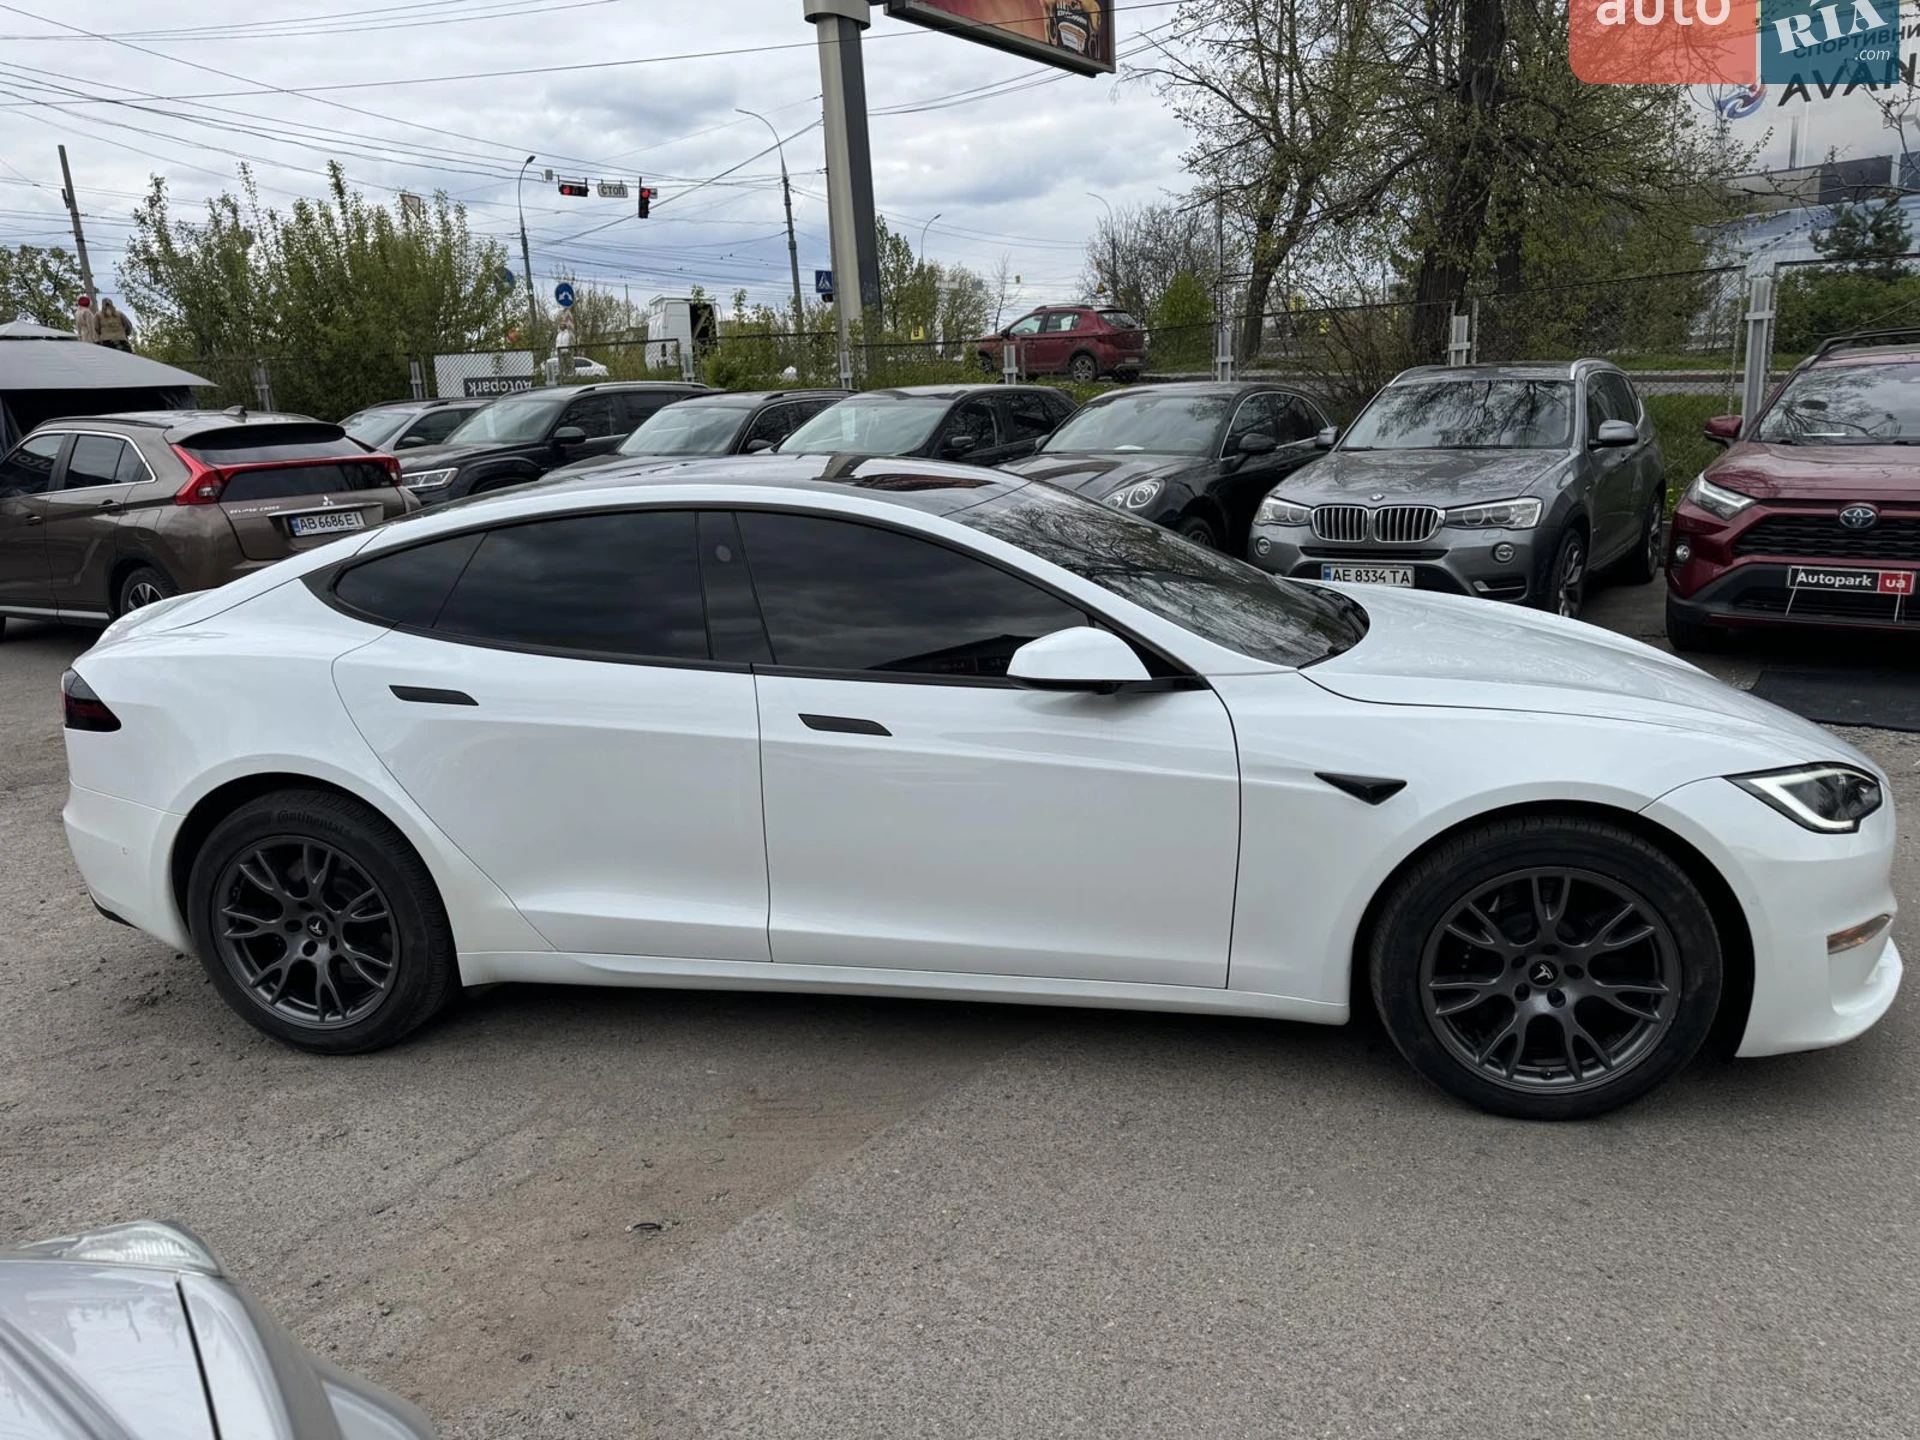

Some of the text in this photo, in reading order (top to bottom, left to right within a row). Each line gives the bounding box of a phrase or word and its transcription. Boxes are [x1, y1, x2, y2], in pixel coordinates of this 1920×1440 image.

[318, 514, 344, 529] 6686
[1332, 569, 1411, 584] AE 8334 TA
[1797, 571, 1872, 588] Autopark
